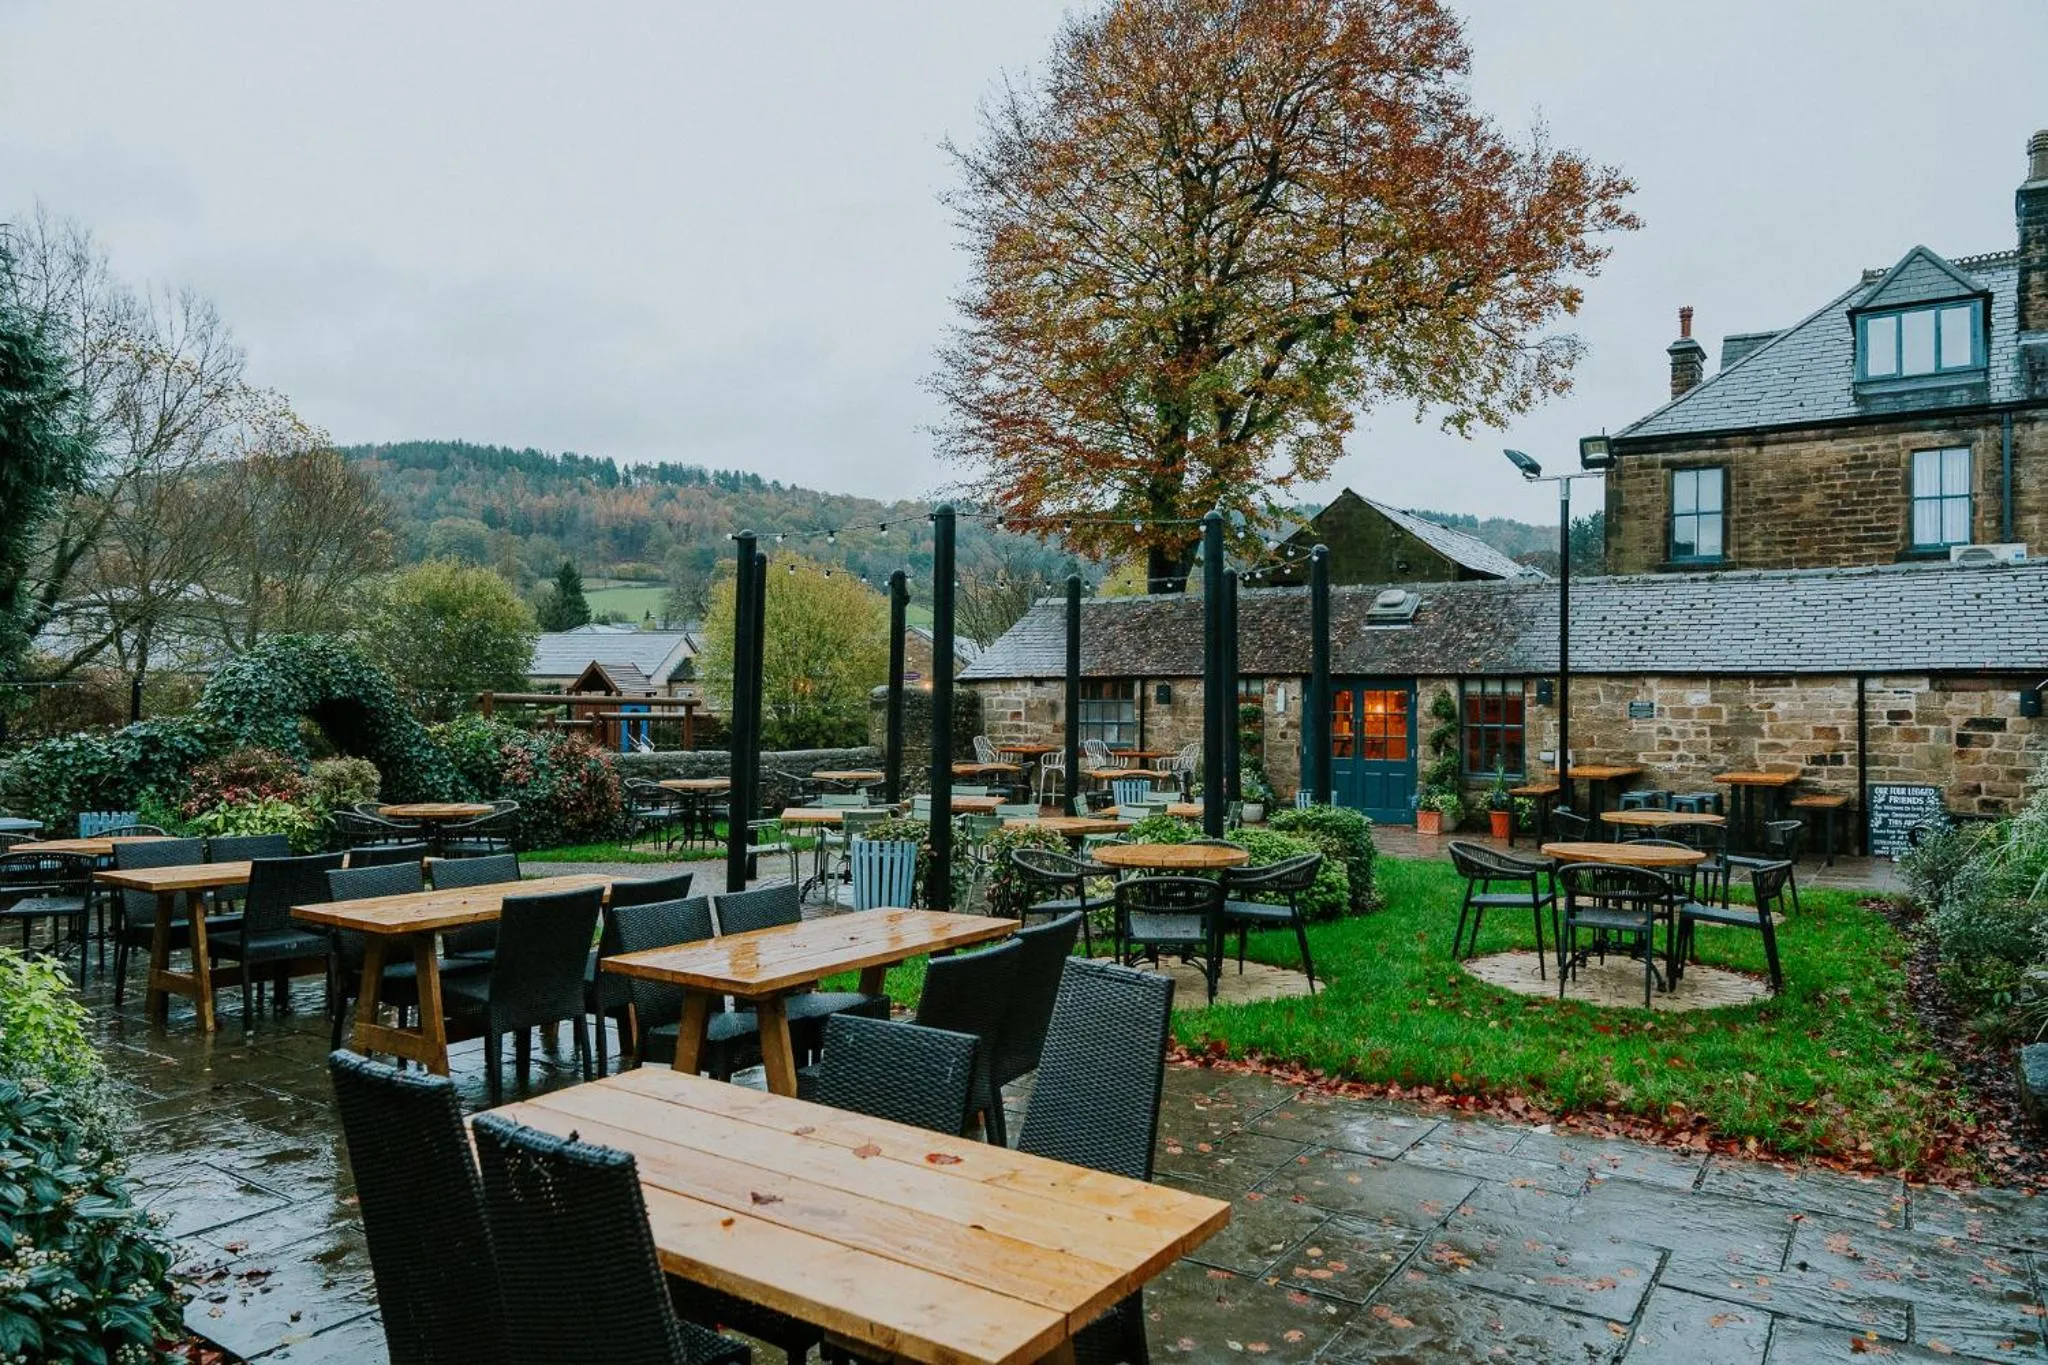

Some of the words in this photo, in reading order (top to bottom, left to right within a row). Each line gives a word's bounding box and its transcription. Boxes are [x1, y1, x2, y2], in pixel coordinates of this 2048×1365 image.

[1890, 787, 1906, 795] FOUR
[1908, 787, 1934, 796] LEGGED
[1889, 796, 1924, 804] FRIENDS
